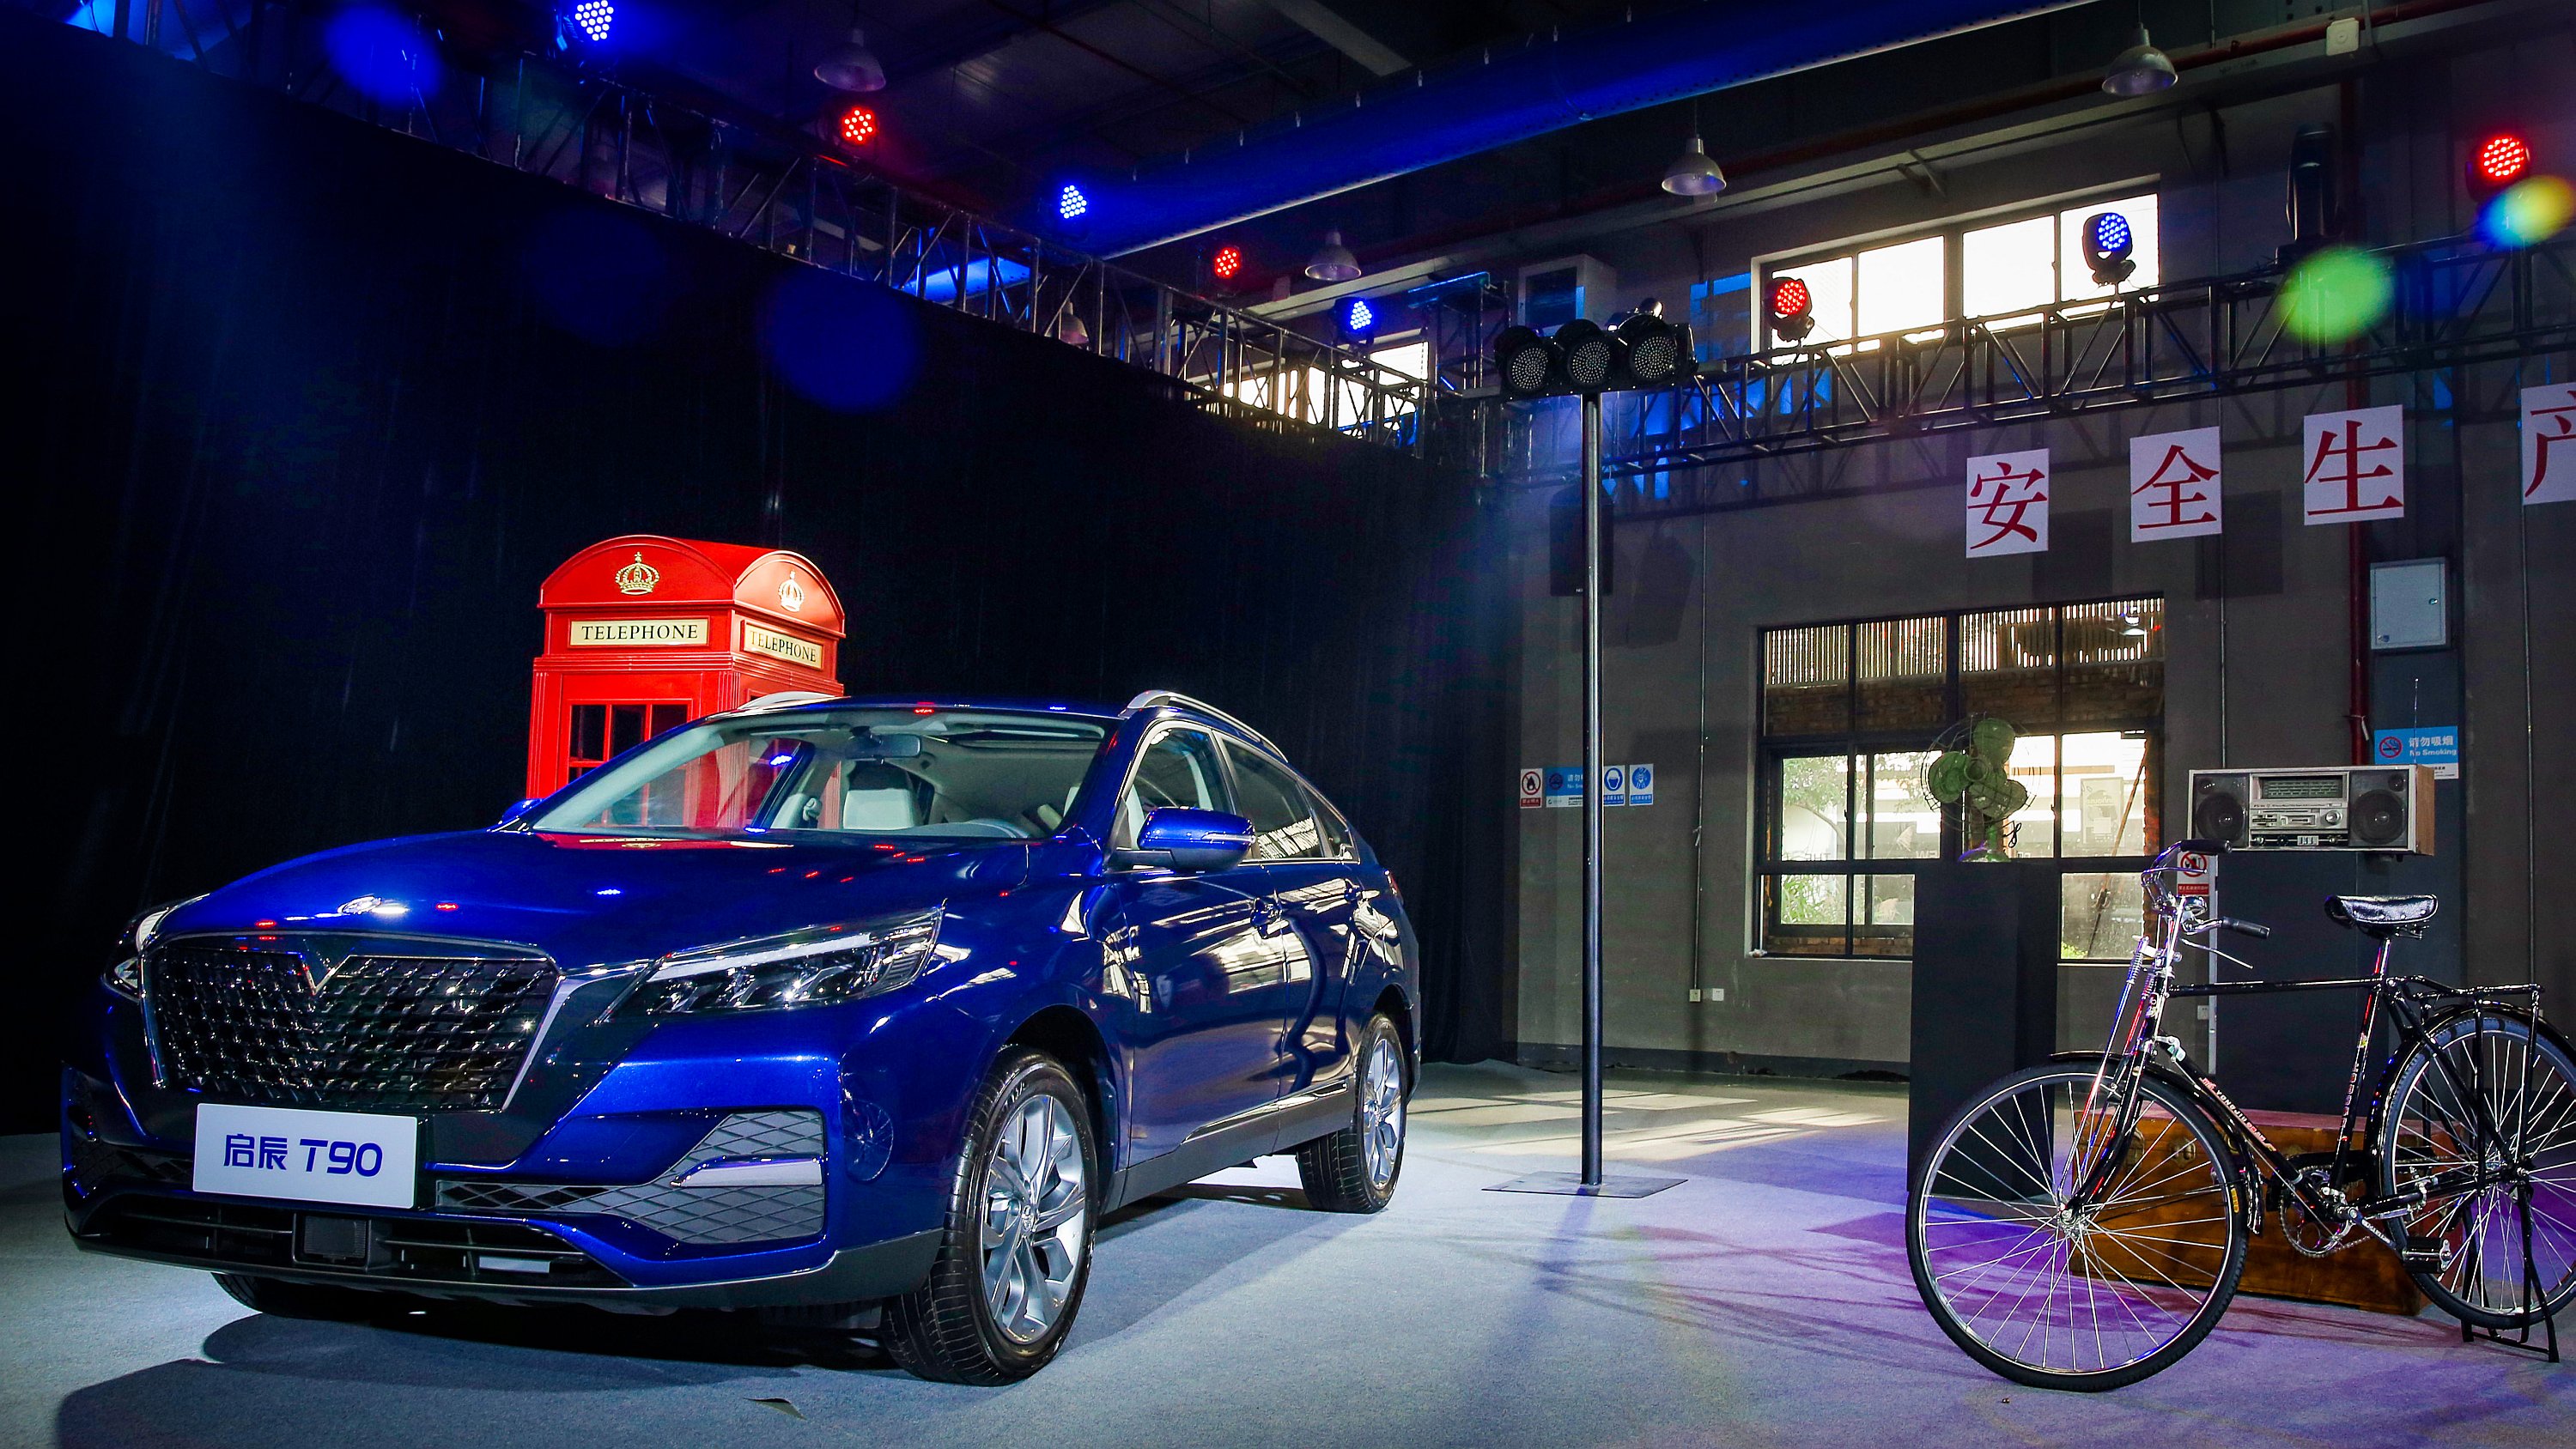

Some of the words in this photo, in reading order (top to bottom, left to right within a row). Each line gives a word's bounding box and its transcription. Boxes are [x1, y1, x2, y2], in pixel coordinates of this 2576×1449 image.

[1967, 462, 2048, 550] 安
[2132, 445, 2220, 530] 全
[2305, 420, 2403, 516] 生
[581, 623, 698, 640] TELEPHONE
[750, 629, 817, 663] TELEPHONE
[223, 1133, 289, 1171] 启辰
[300, 1138, 383, 1178] T90
